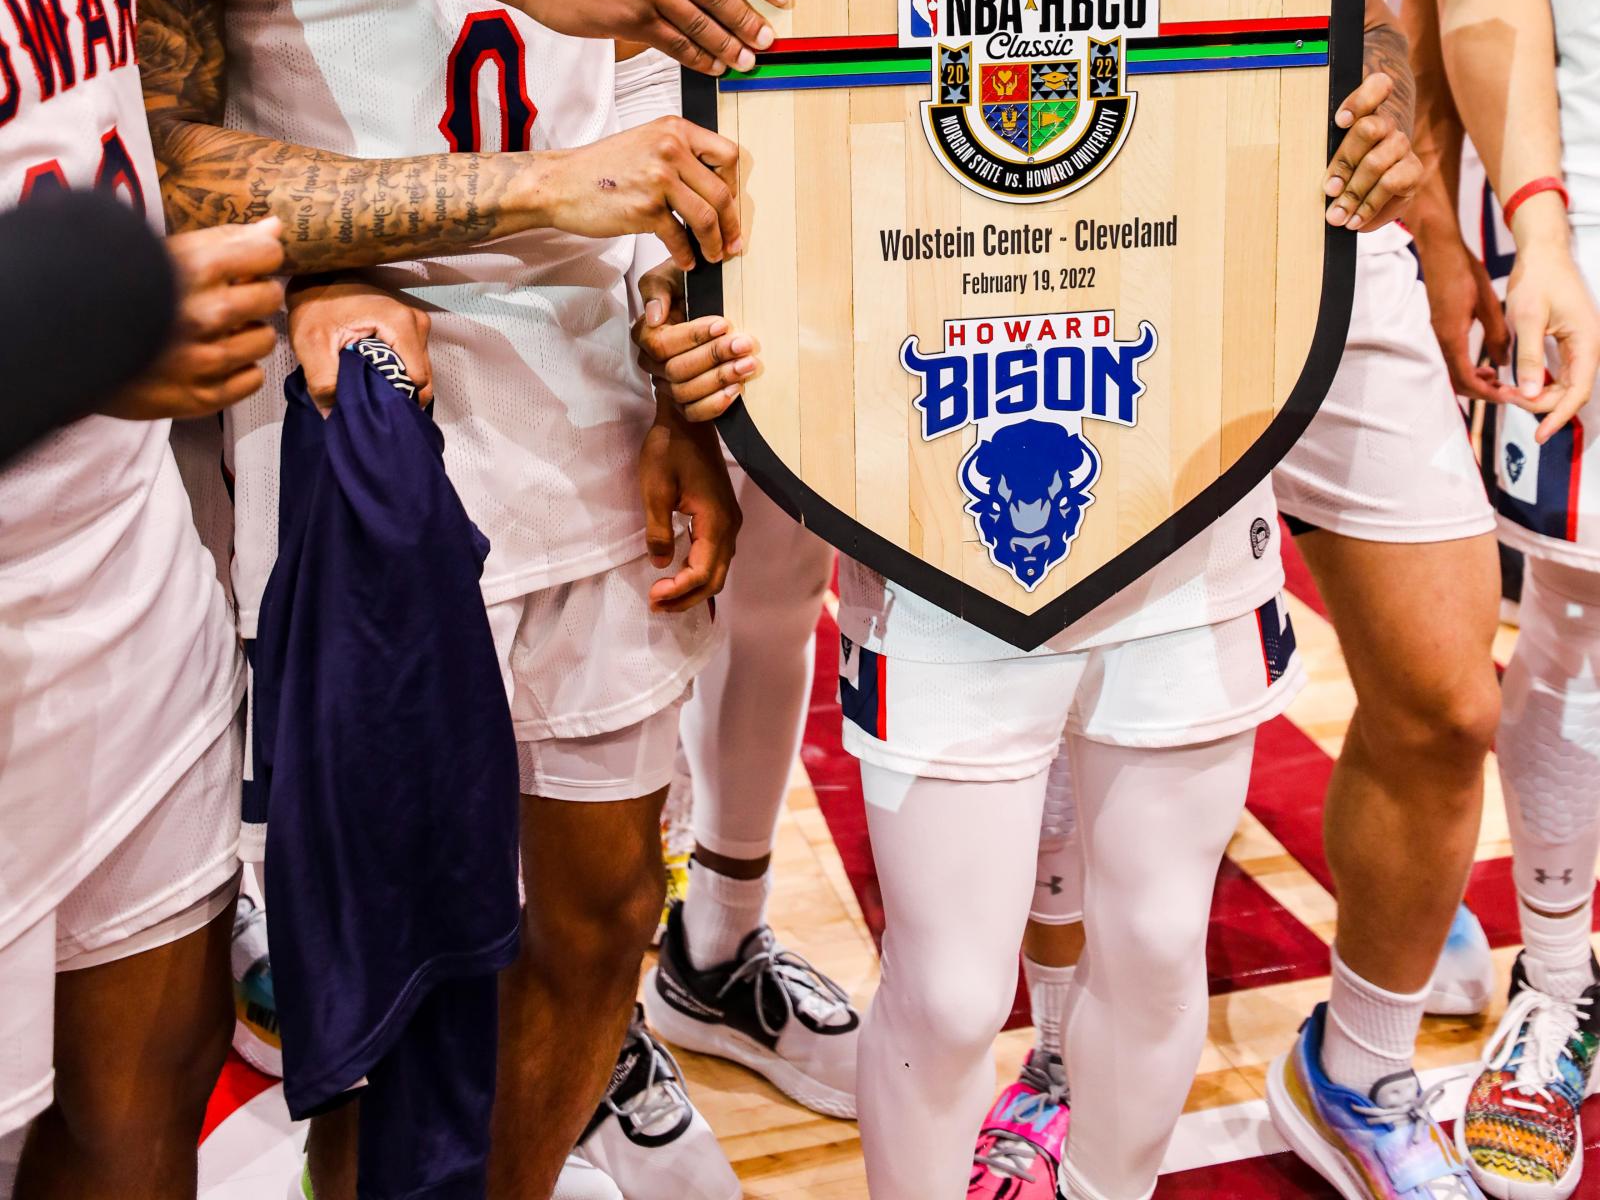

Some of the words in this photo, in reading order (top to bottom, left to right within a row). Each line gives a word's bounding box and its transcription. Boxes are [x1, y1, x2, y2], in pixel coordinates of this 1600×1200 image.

[986, 31, 1075, 60] Classic
[947, 64, 964, 85] 20
[1096, 58, 1113, 79] 22
[939, 114, 976, 164] MORGAN
[968, 154, 1003, 184] STATE
[1026, 159, 1075, 188] HOWARD
[1074, 107, 1119, 169] UNIVERSITY
[879, 226, 975, 262] Wolstein
[983, 224, 1053, 257] Center
[1074, 215, 1178, 251] Cleveland
[962, 271, 1028, 295] February
[1033, 269, 1055, 293] 19,
[1060, 267, 1096, 289] 2022
[948, 315, 1111, 347] HOWARD
[905, 328, 1154, 437] BISON
